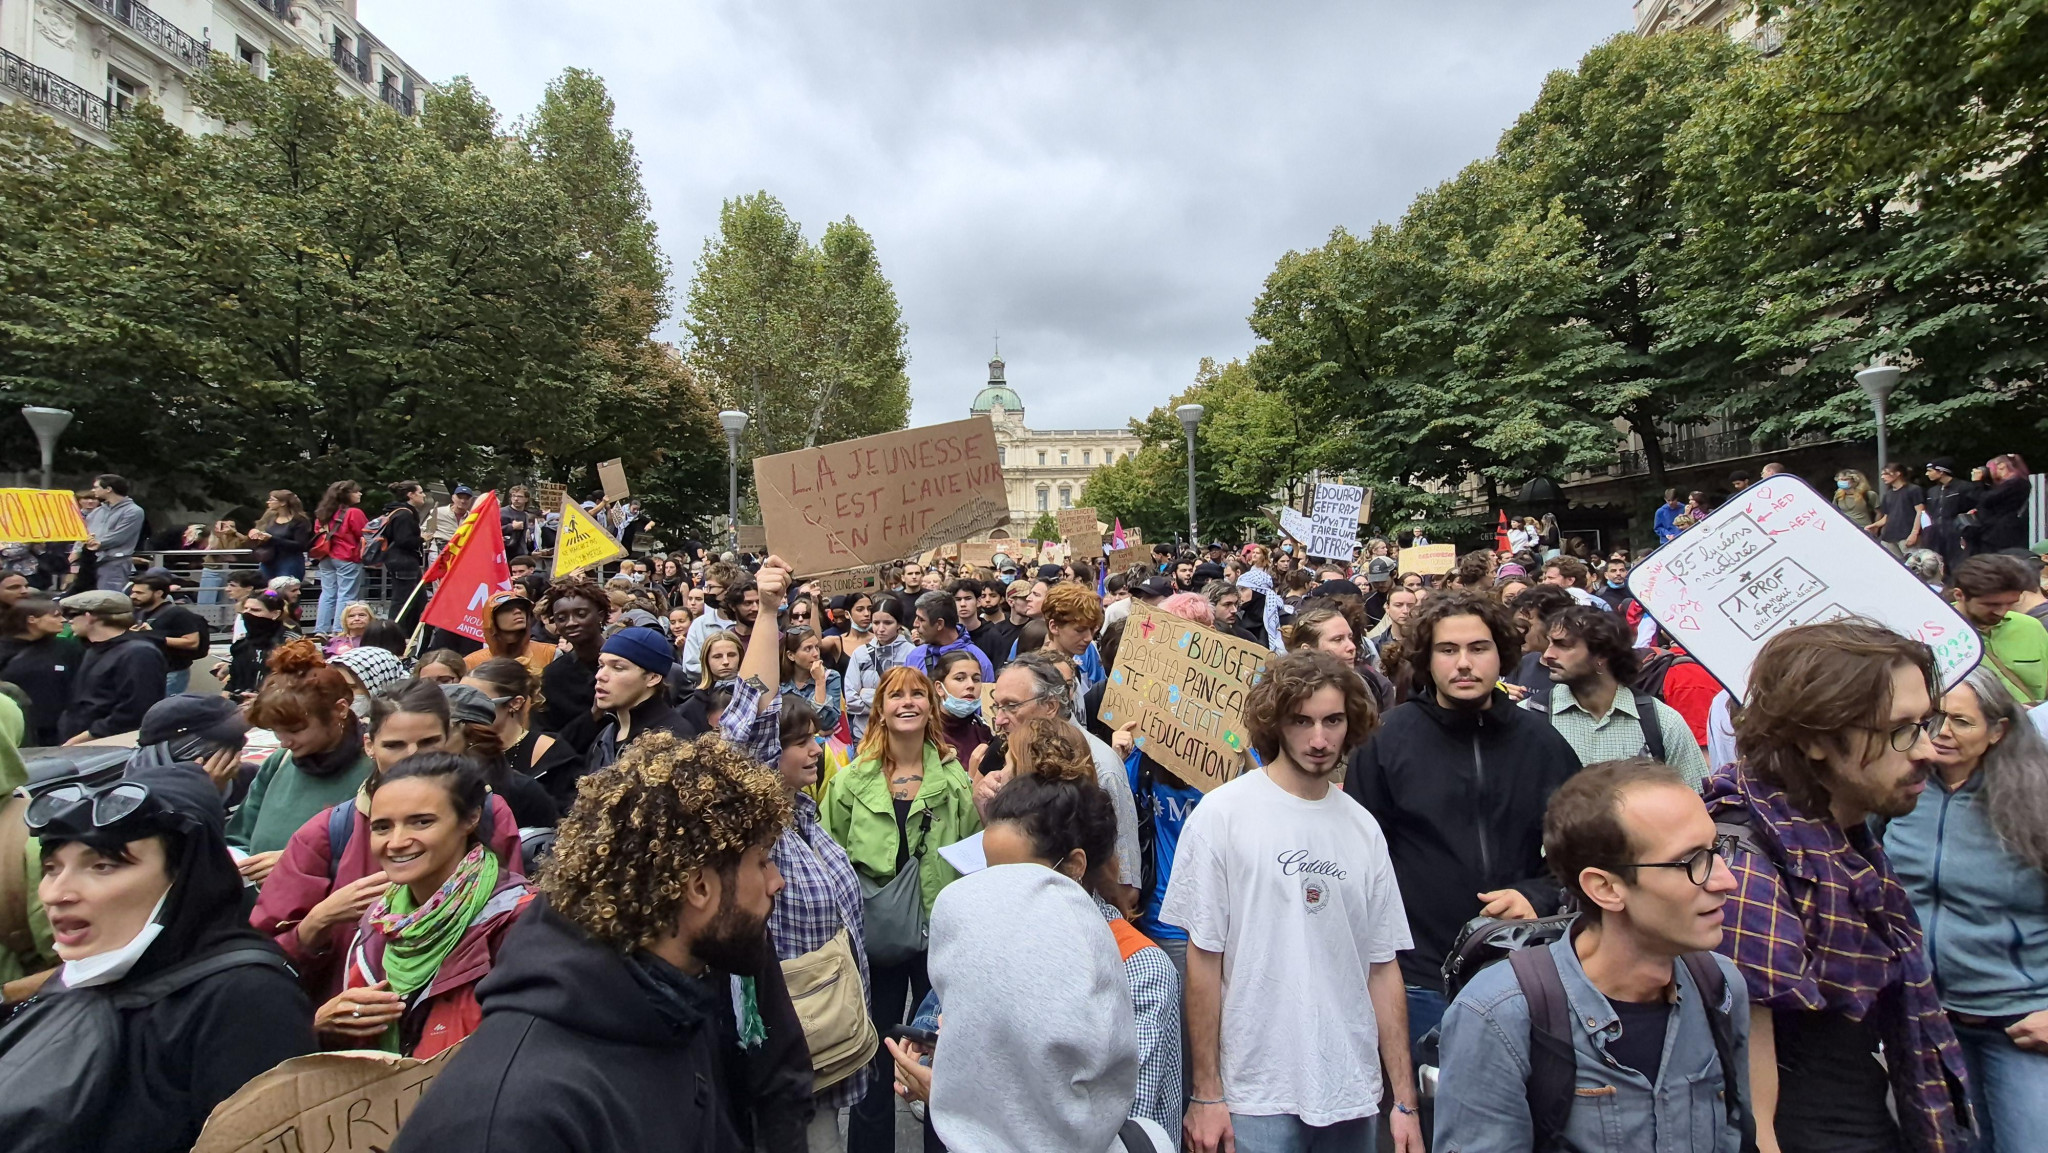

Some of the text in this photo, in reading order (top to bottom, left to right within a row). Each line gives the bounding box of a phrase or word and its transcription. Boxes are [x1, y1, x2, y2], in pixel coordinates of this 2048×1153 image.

[791, 433, 984, 496] LA JEUNESSE
[802, 463, 1004, 526] C'EST L'AVENIR
[1313, 501, 1359, 515] GEFFRAY
[1315, 483, 1362, 502] ÉDOUARD
[1771, 493, 1795, 512] AED
[825, 507, 935, 555] EN FAIT
[1310, 524, 1356, 540] FAIRE UNE
[1311, 513, 1357, 530] ON VA TE
[1307, 535, 1354, 557] JOFFRAY
[1674, 527, 1753, 577] 25 lycéens
[834, 575, 863, 591] CONDÉS
[1747, 566, 1785, 600] PROF
[1155, 619, 1186, 653] DE
[1187, 631, 1264, 683] BUDGET
[1121, 638, 1247, 723] DANS LA PANCA
[1123, 664, 1145, 692] TE
[1106, 686, 1135, 718] DANS
[1277, 849, 1348, 881] Cadillac
